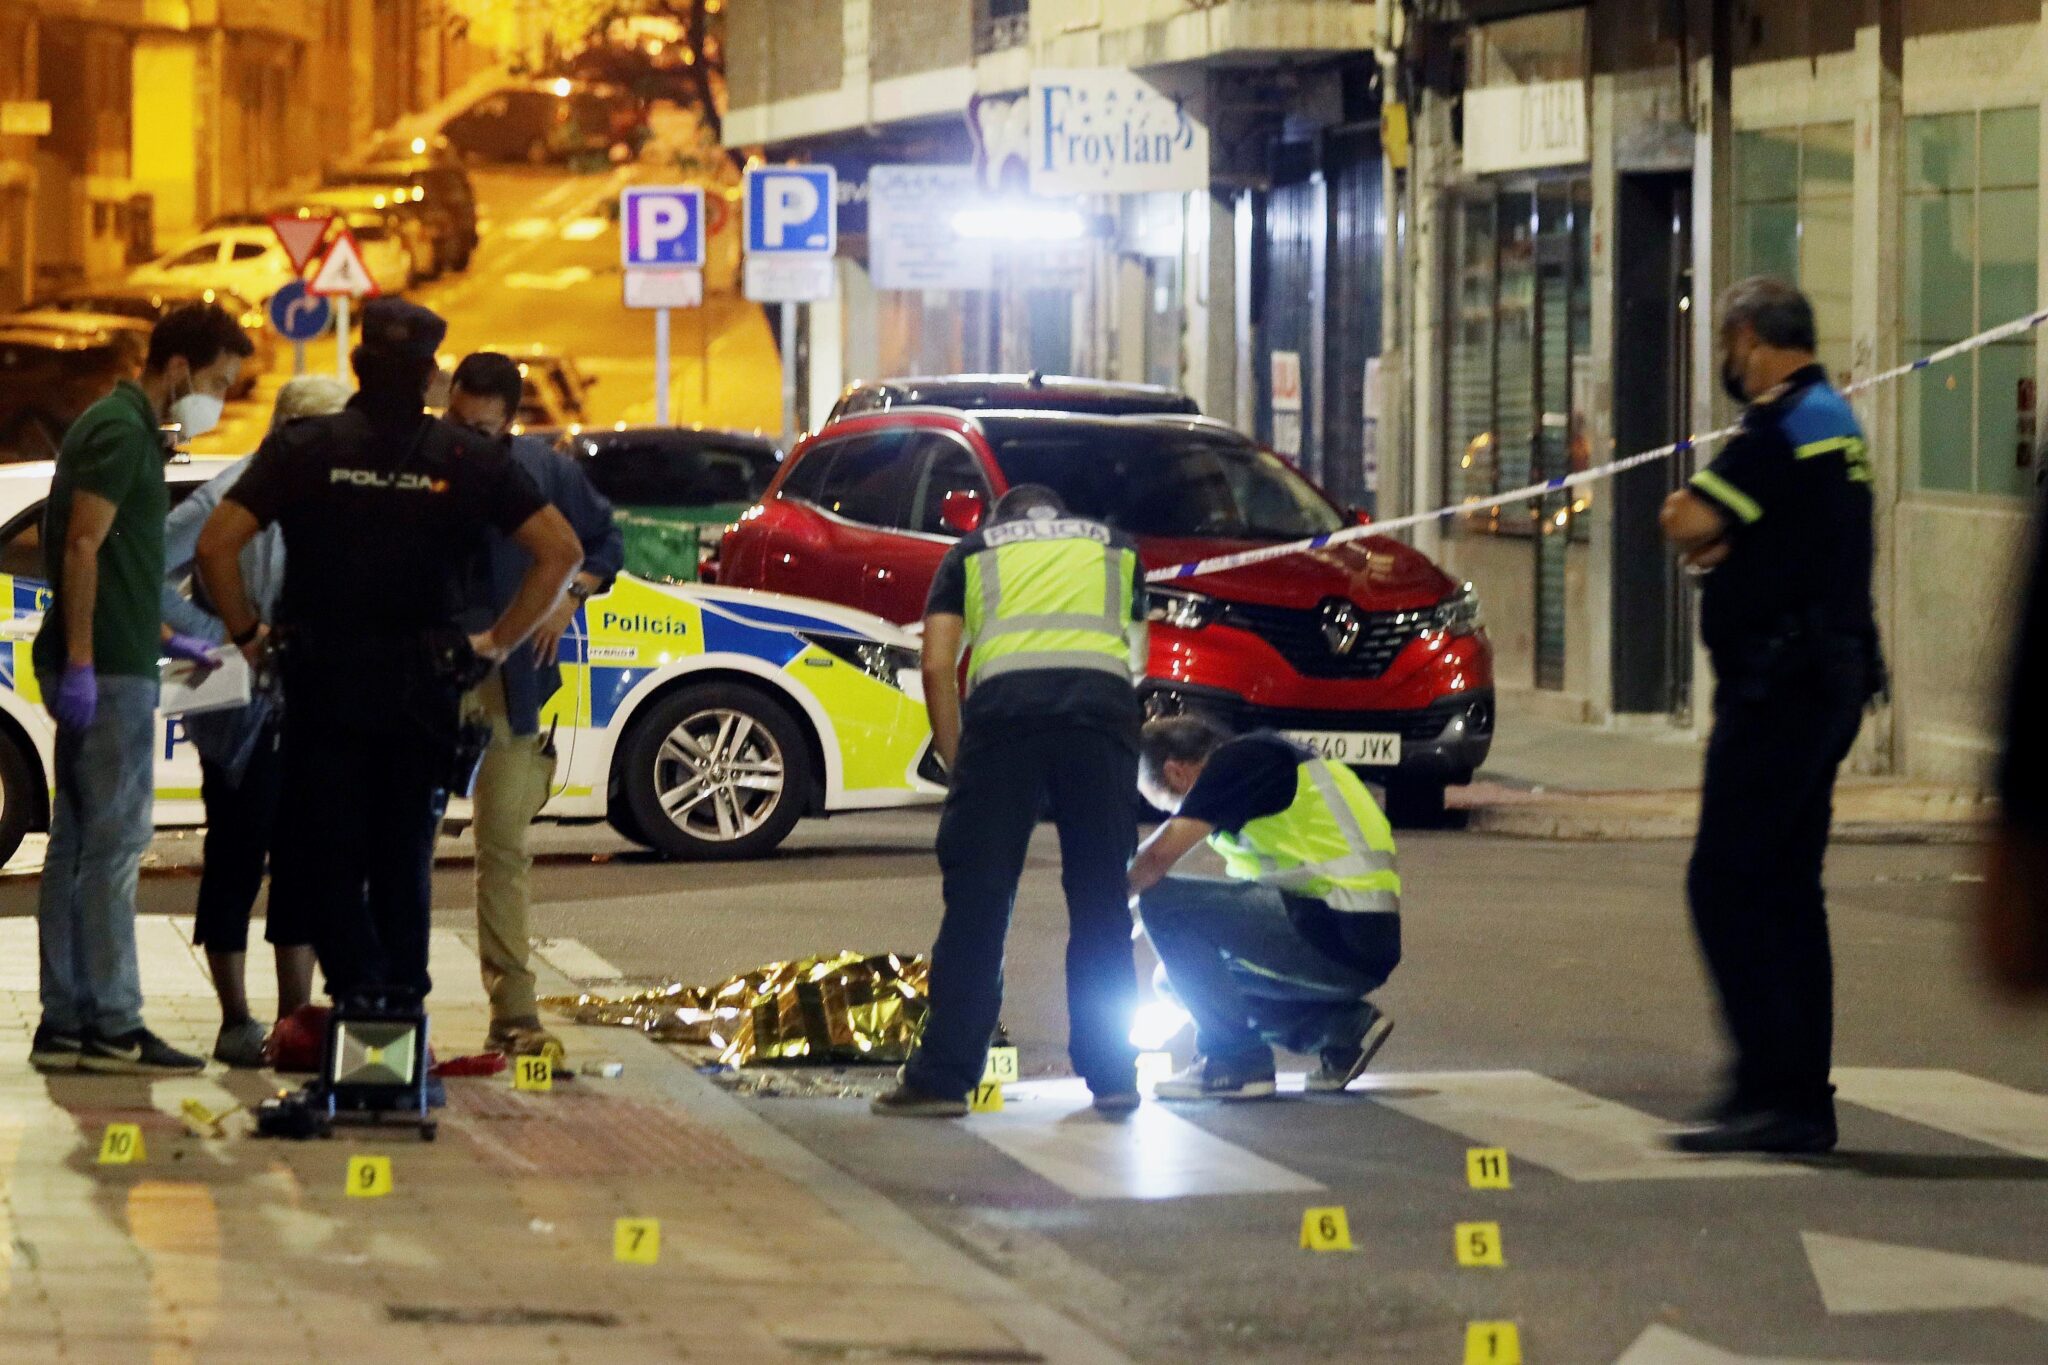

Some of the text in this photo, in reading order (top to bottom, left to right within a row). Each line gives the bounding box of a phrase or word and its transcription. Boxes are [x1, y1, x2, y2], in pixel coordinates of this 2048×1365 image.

[1041, 86, 1172, 178] Froylán
[763, 176, 819, 247] P
[637, 197, 689, 260] P
[1356, 738, 1393, 759] JVK
[524, 1061, 548, 1083] 18
[991, 1056, 1012, 1075] 13
[972, 1083, 996, 1105] 17
[108, 1132, 131, 1155] 10
[359, 1164, 376, 1190] 9
[1476, 1155, 1501, 1179] 11
[629, 1226, 646, 1252] 7
[1318, 1214, 1338, 1241] 6
[1469, 1231, 1489, 1258] 5
[1486, 1331, 1498, 1358] 1
